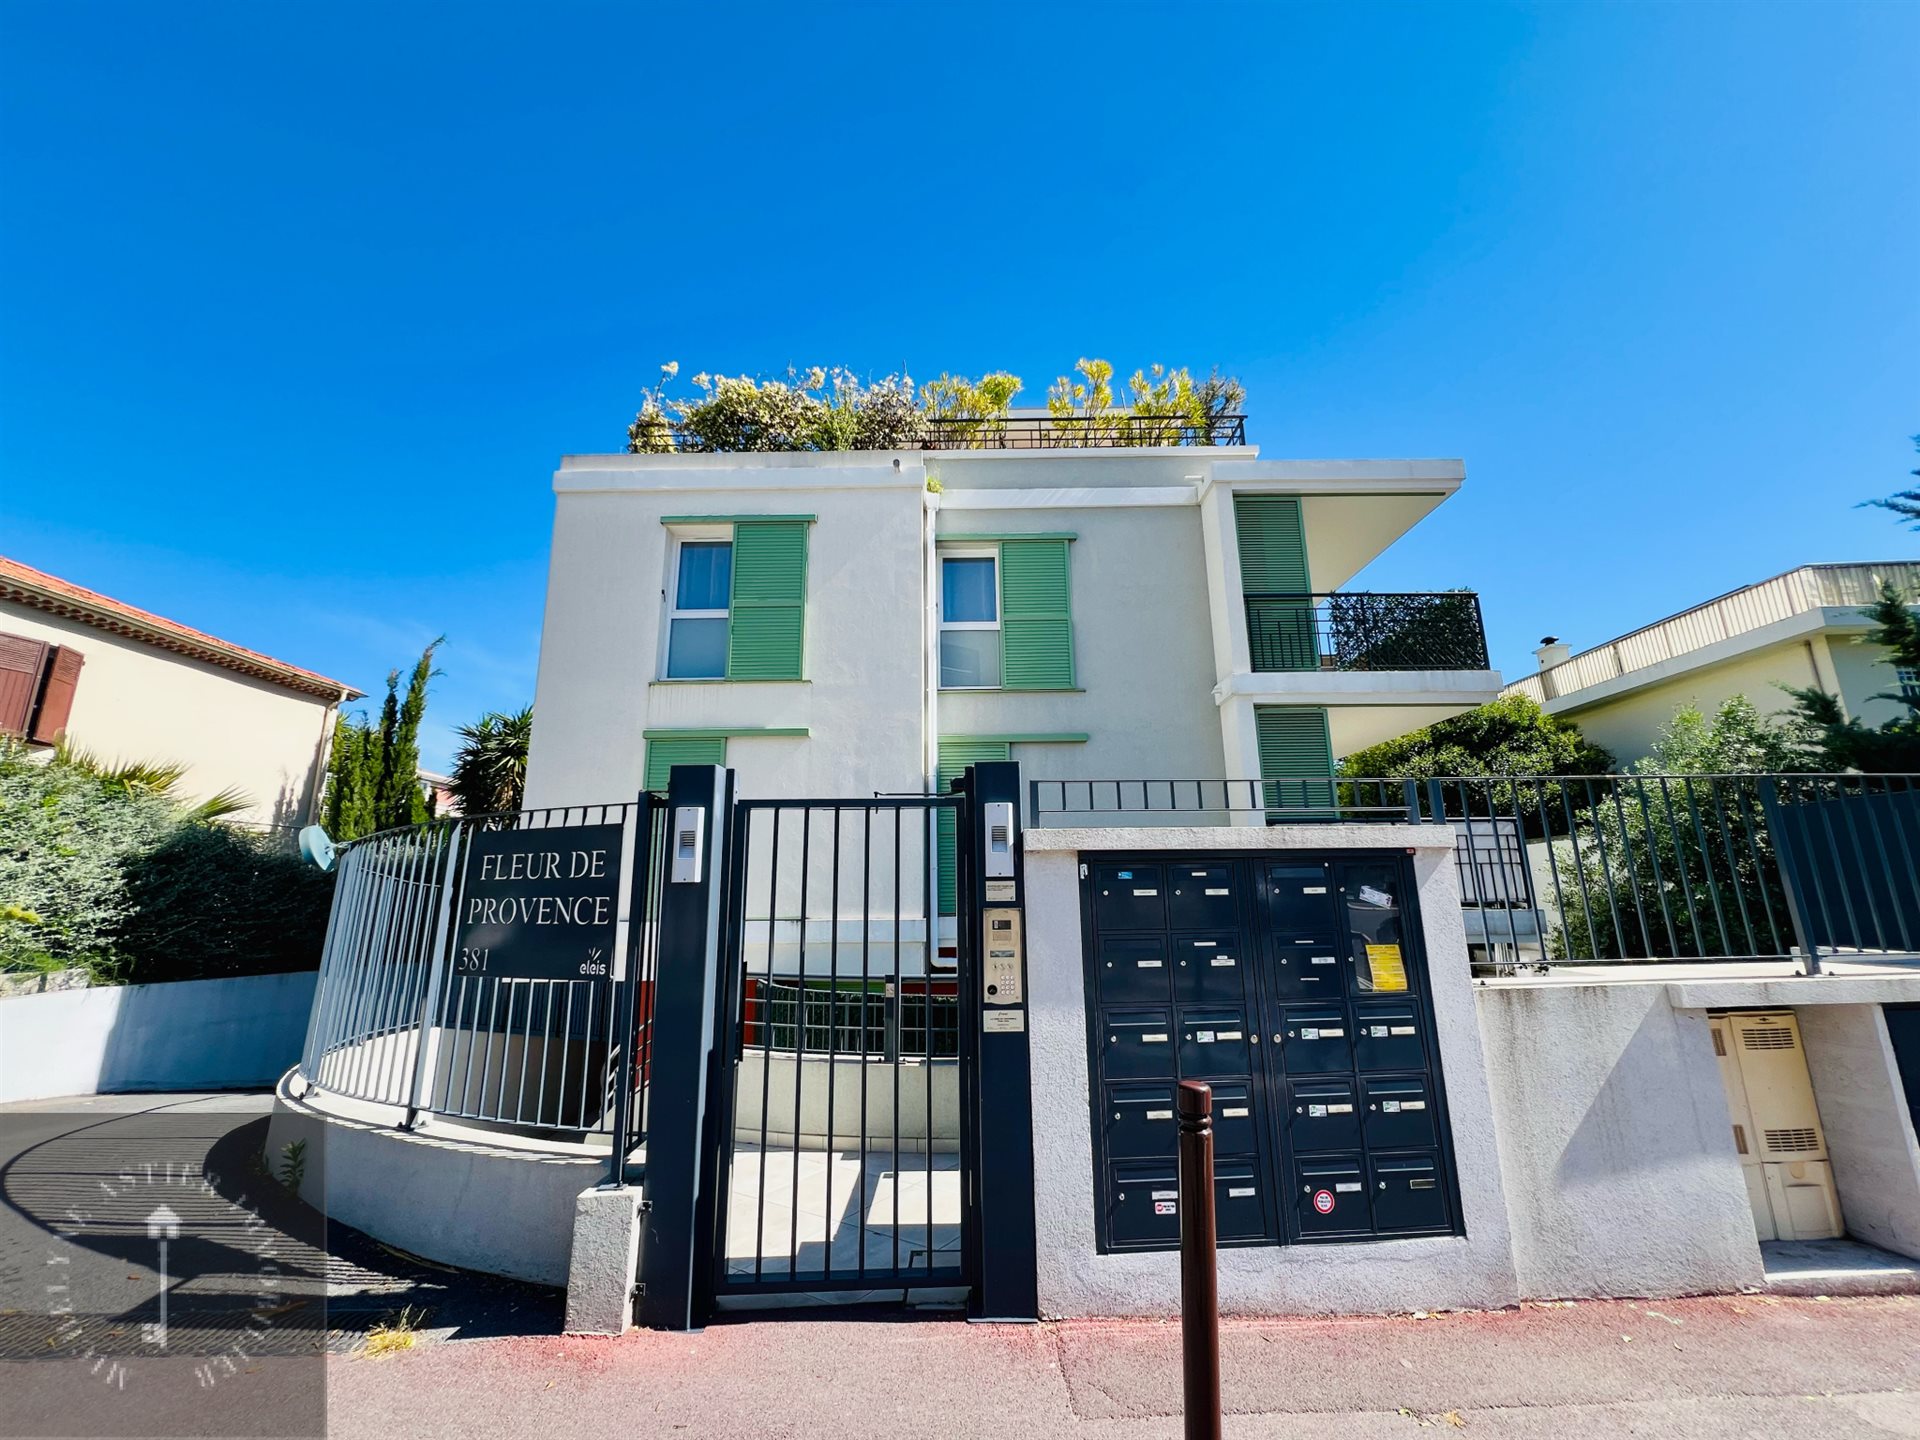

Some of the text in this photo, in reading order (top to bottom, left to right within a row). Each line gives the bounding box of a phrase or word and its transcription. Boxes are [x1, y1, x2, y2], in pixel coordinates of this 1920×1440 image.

[480, 850, 607, 881] FLEUR DE
[467, 896, 610, 925] PROVENCE
[458, 948, 489, 972] 381
